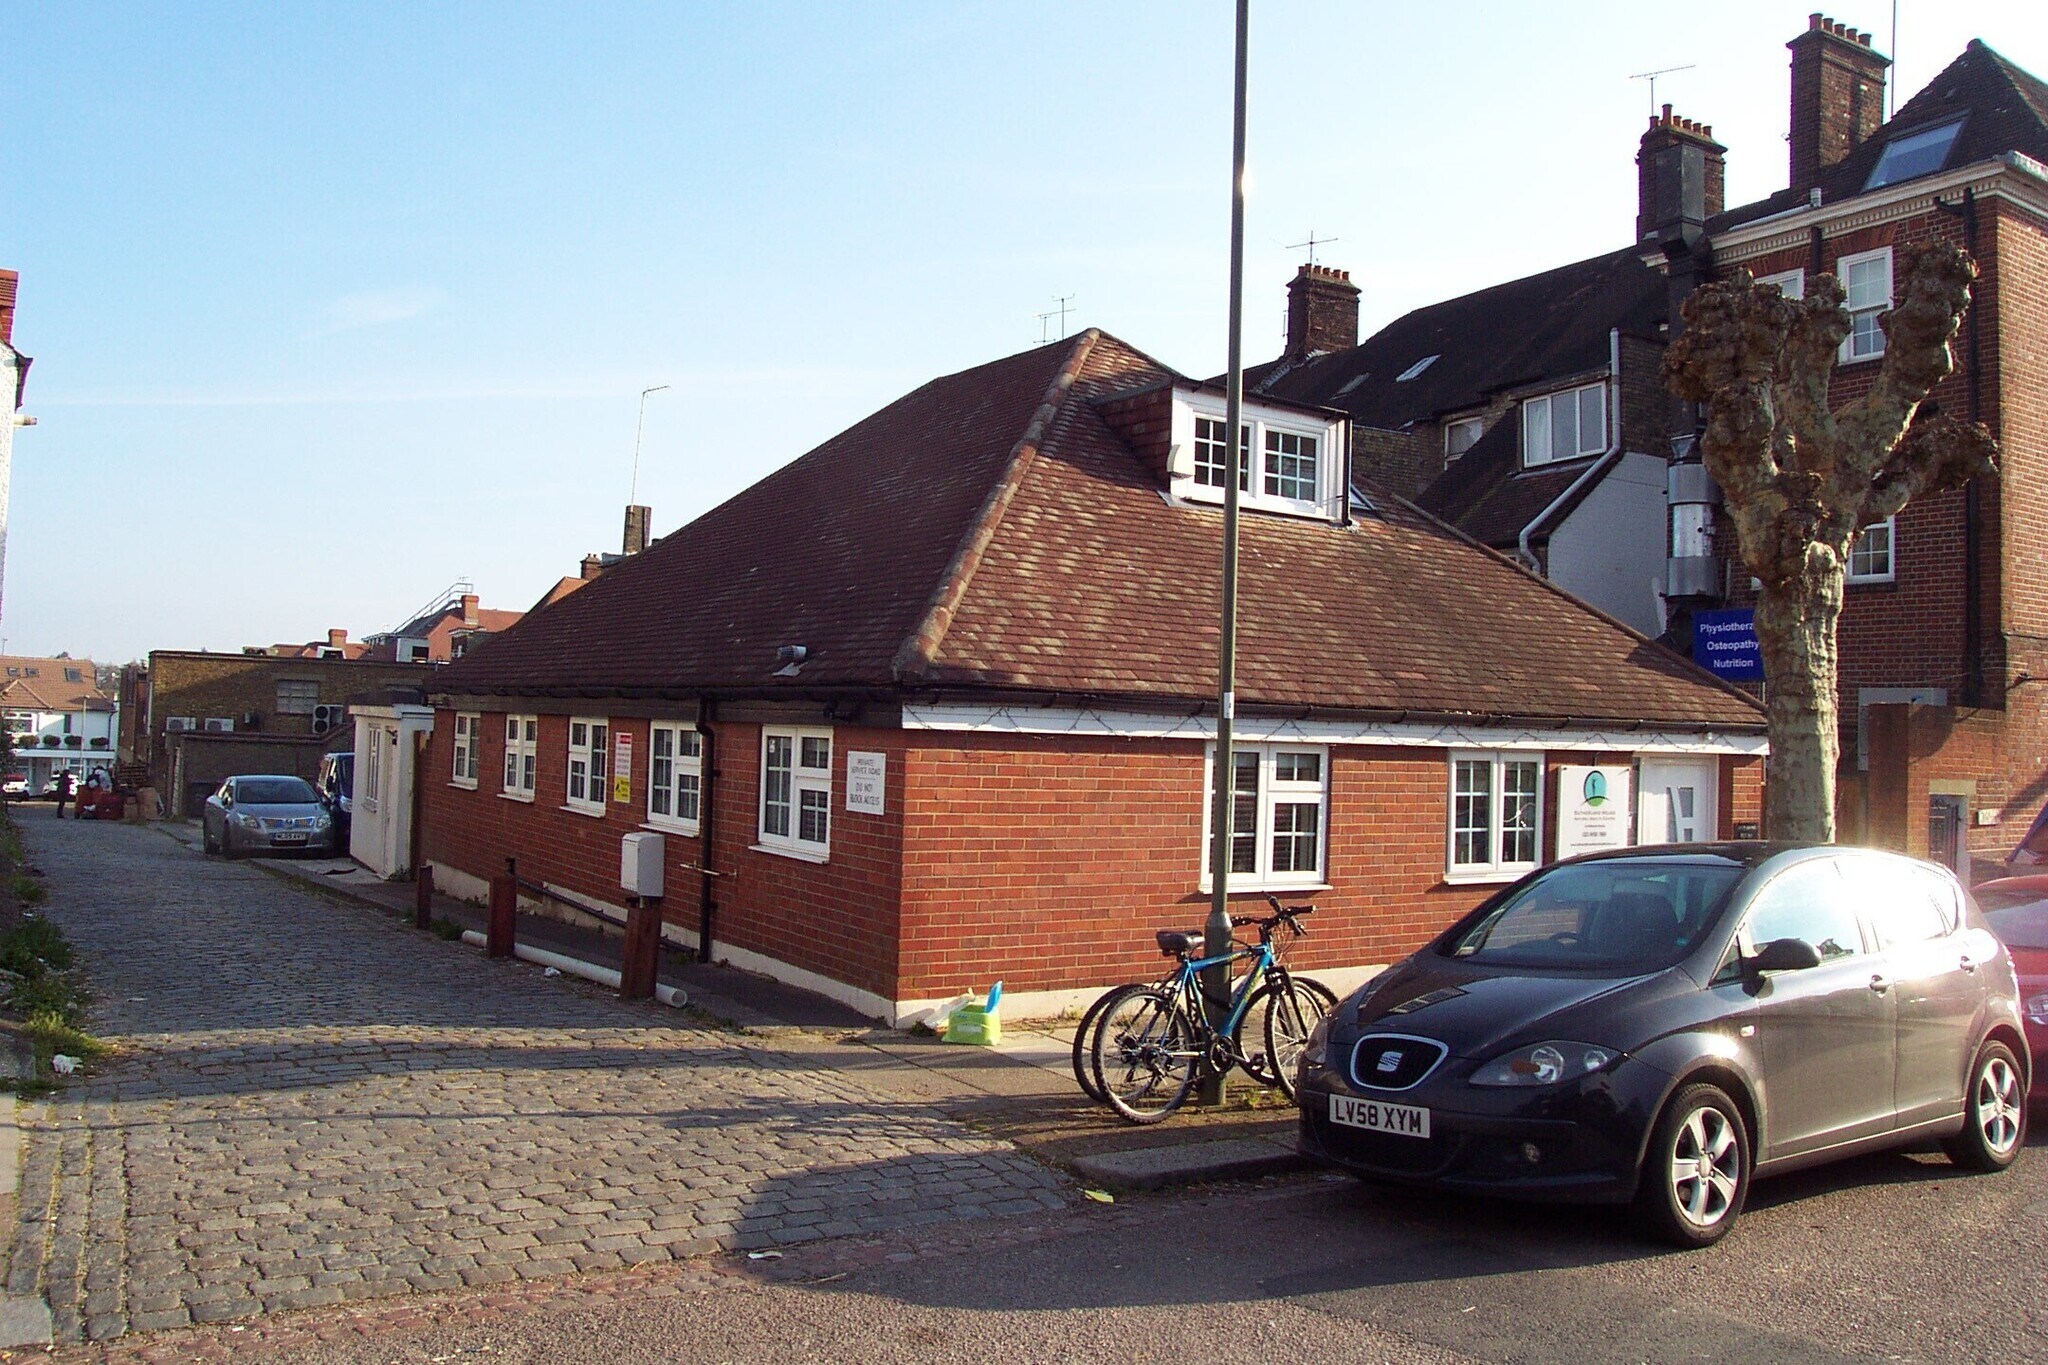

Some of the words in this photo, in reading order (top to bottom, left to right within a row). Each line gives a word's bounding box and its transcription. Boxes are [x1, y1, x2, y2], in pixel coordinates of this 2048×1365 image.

[1706, 640, 1760, 652] Osteopathy
[1713, 658, 1754, 668] Nutrition
[1335, 1098, 1378, 1126] LV58
[1383, 1106, 1422, 1133] XYM
